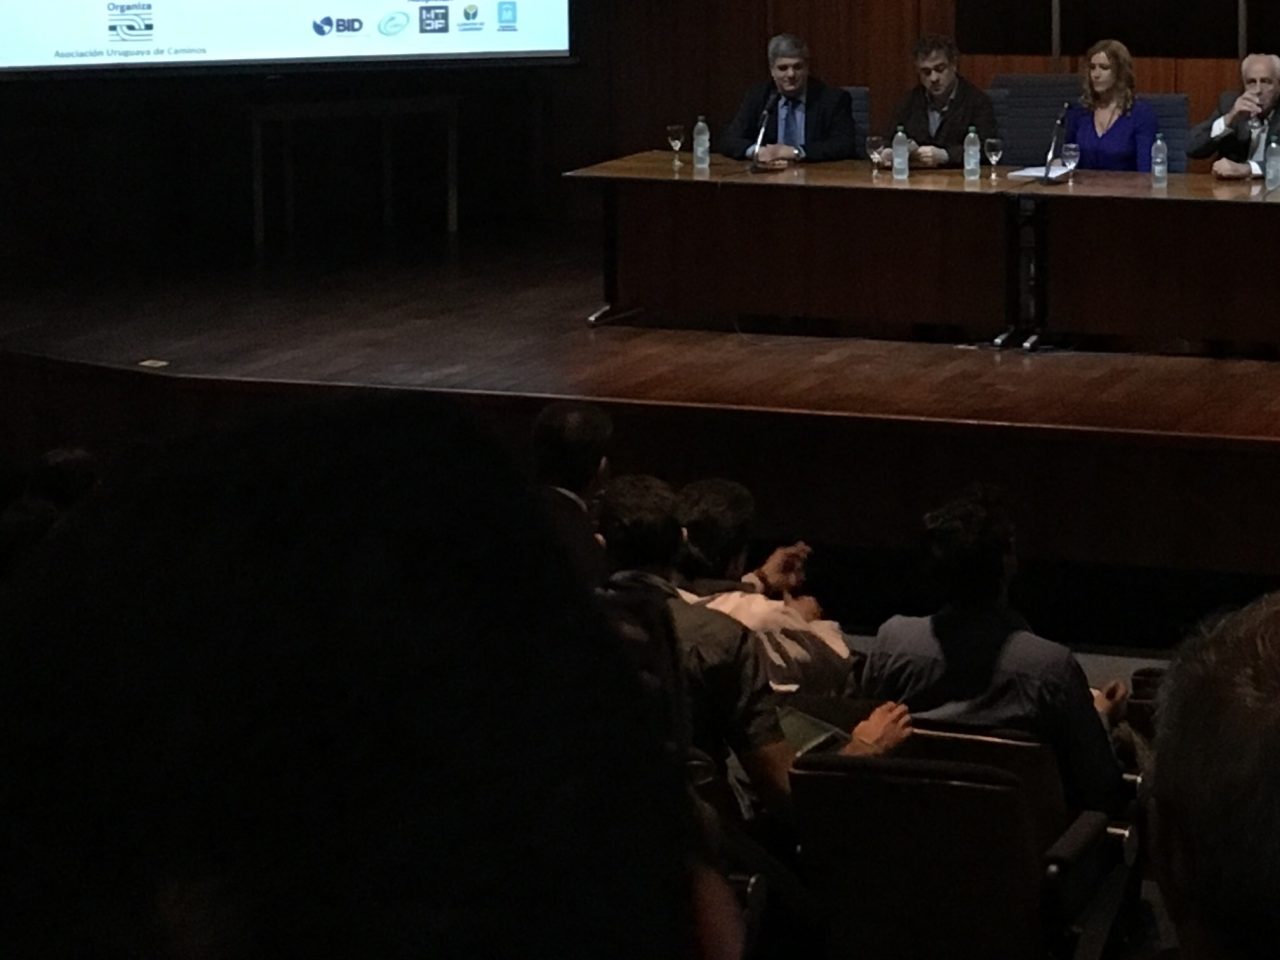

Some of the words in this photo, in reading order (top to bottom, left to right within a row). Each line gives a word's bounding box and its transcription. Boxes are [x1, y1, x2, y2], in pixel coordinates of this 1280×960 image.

[107, 2, 152, 13] Organiza
[335, 18, 363, 33] BID
[153, 47, 165, 56] de
